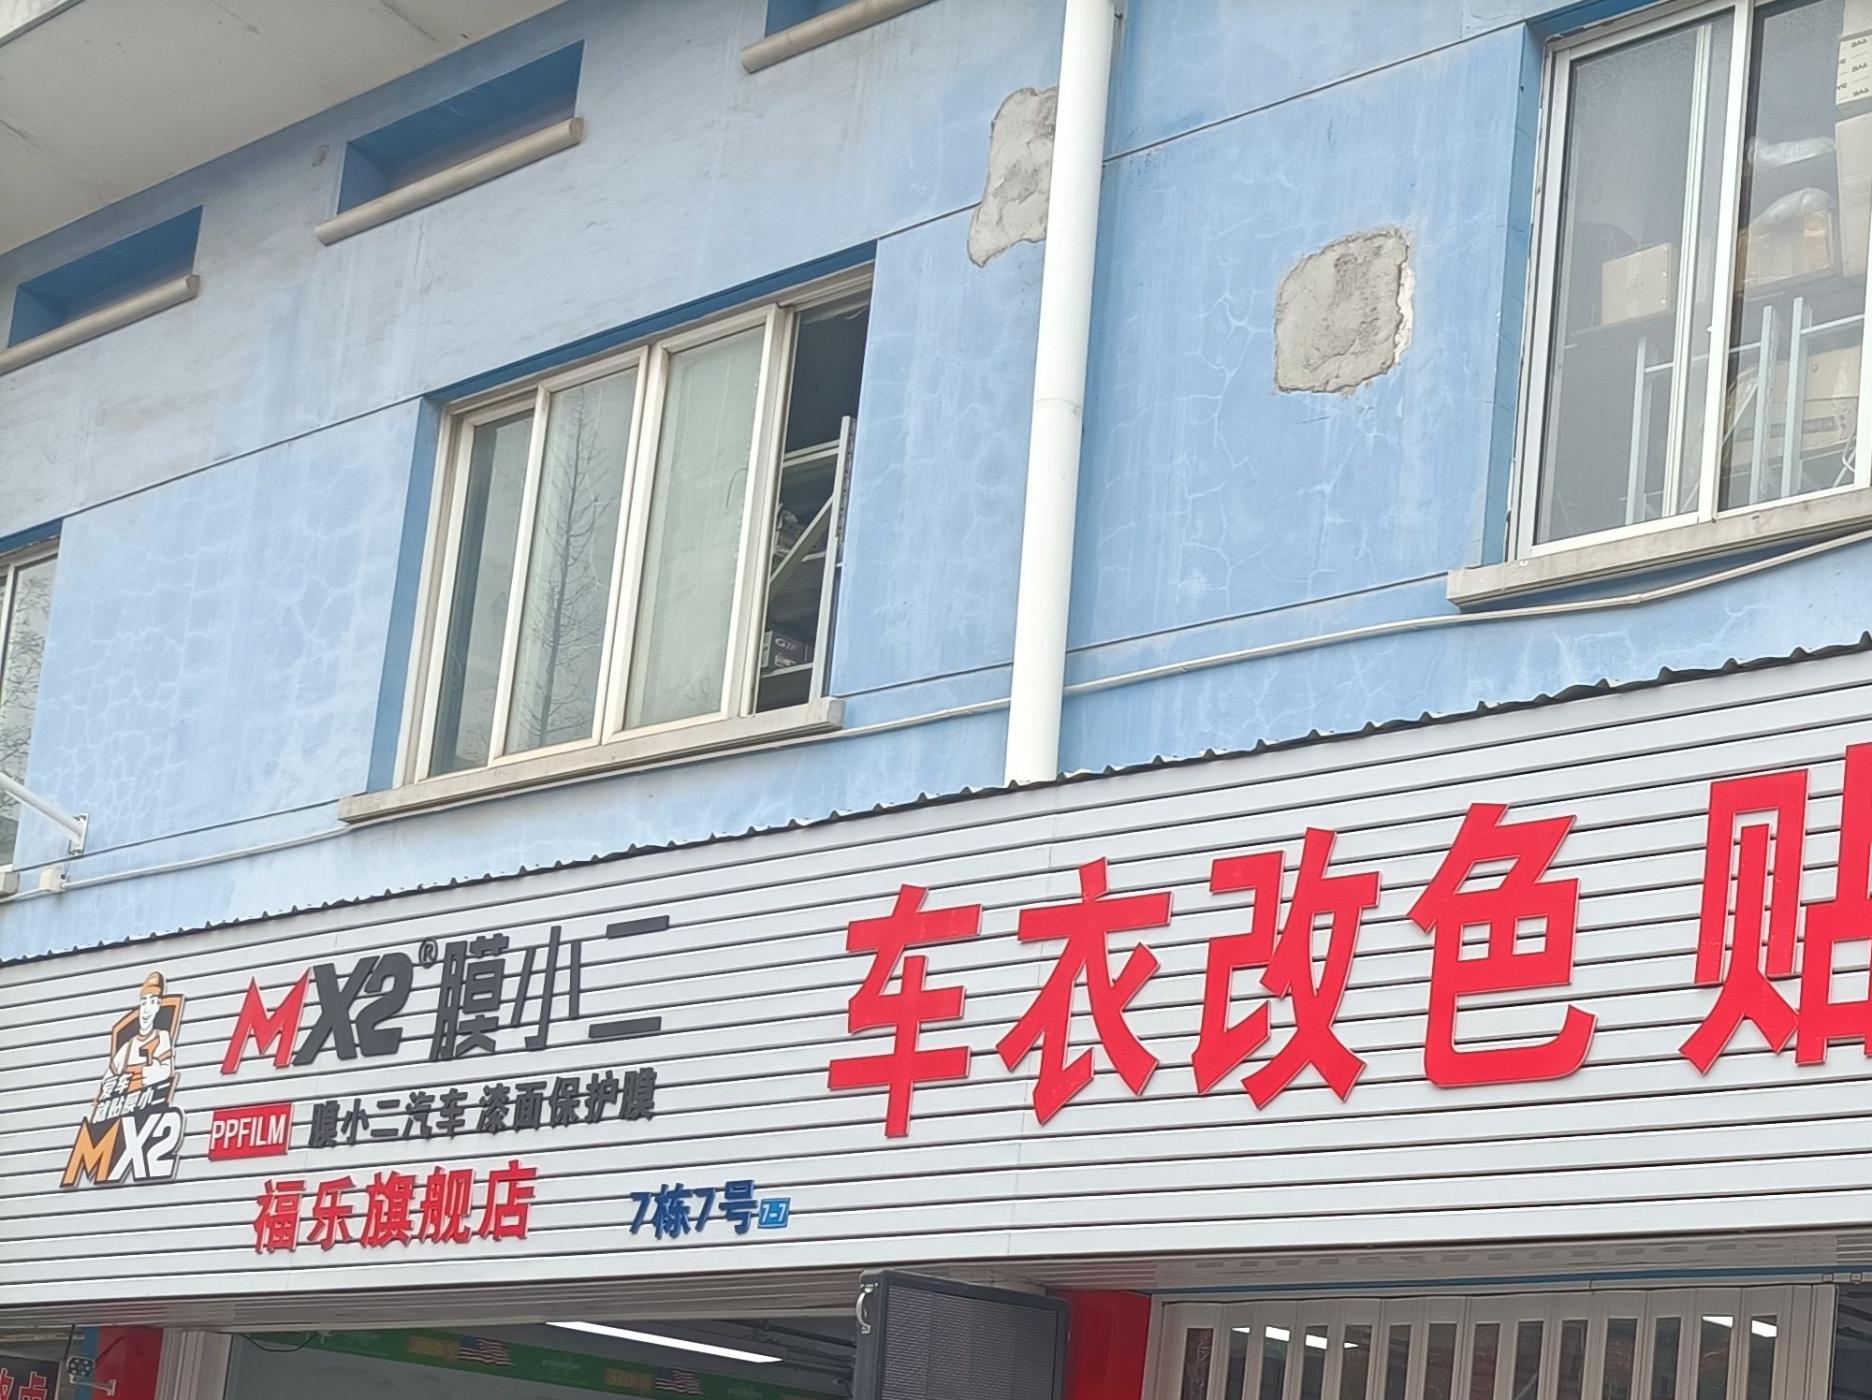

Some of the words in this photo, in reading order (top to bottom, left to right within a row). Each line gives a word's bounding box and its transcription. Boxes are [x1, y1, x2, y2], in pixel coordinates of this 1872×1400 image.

[827, 801, 1598, 1138] 车衣改色
[61, 1109, 182, 1187] MX2
[210, 1113, 287, 1150] PPFILM
[252, 1158, 539, 1254] 福乐旗舰店
[628, 1180, 758, 1241] 7栋7号
